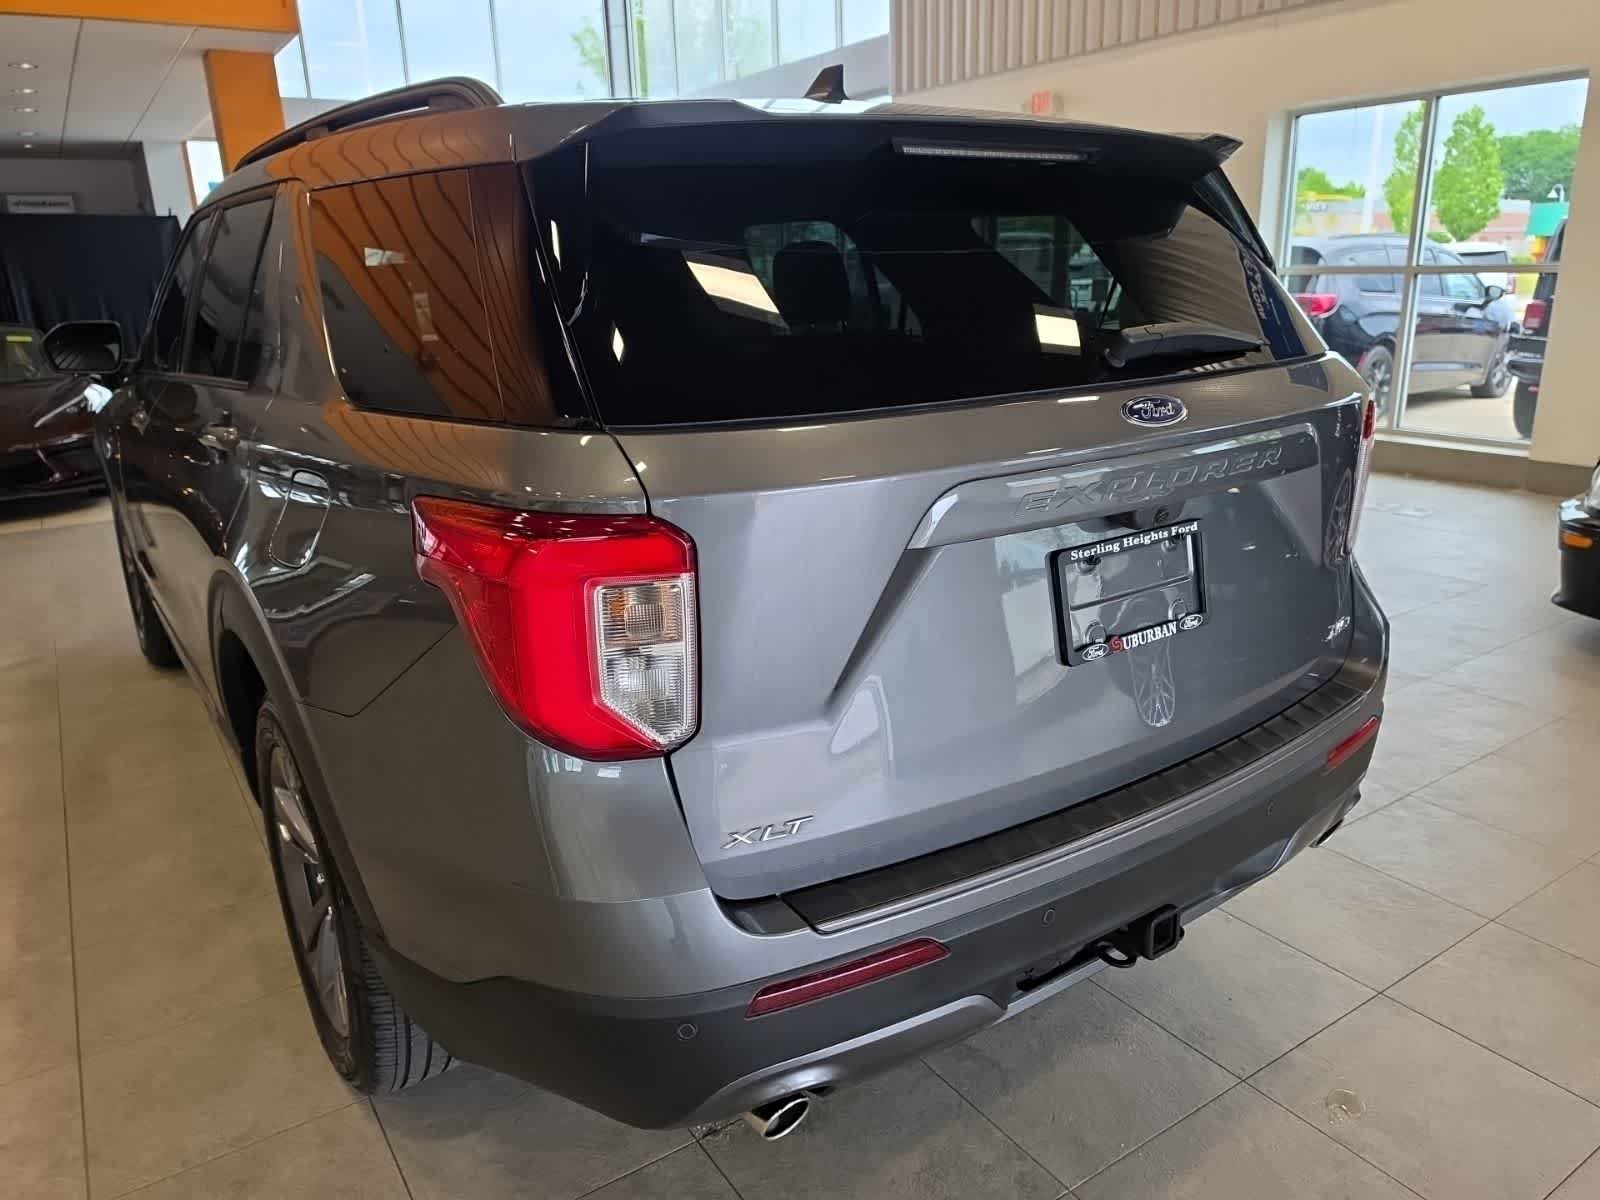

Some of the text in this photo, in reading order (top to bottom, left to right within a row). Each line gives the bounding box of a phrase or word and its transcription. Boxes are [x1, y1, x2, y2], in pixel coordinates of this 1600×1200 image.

[1130, 399, 1176, 420] Ford
[1014, 447, 1282, 520] EXPLORER
[1070, 521, 1199, 561] Sterling Heights Ford
[1084, 644, 1105, 659] Ford
[1108, 621, 1177, 653] SUBURBAN
[720, 815, 815, 850] XLT
